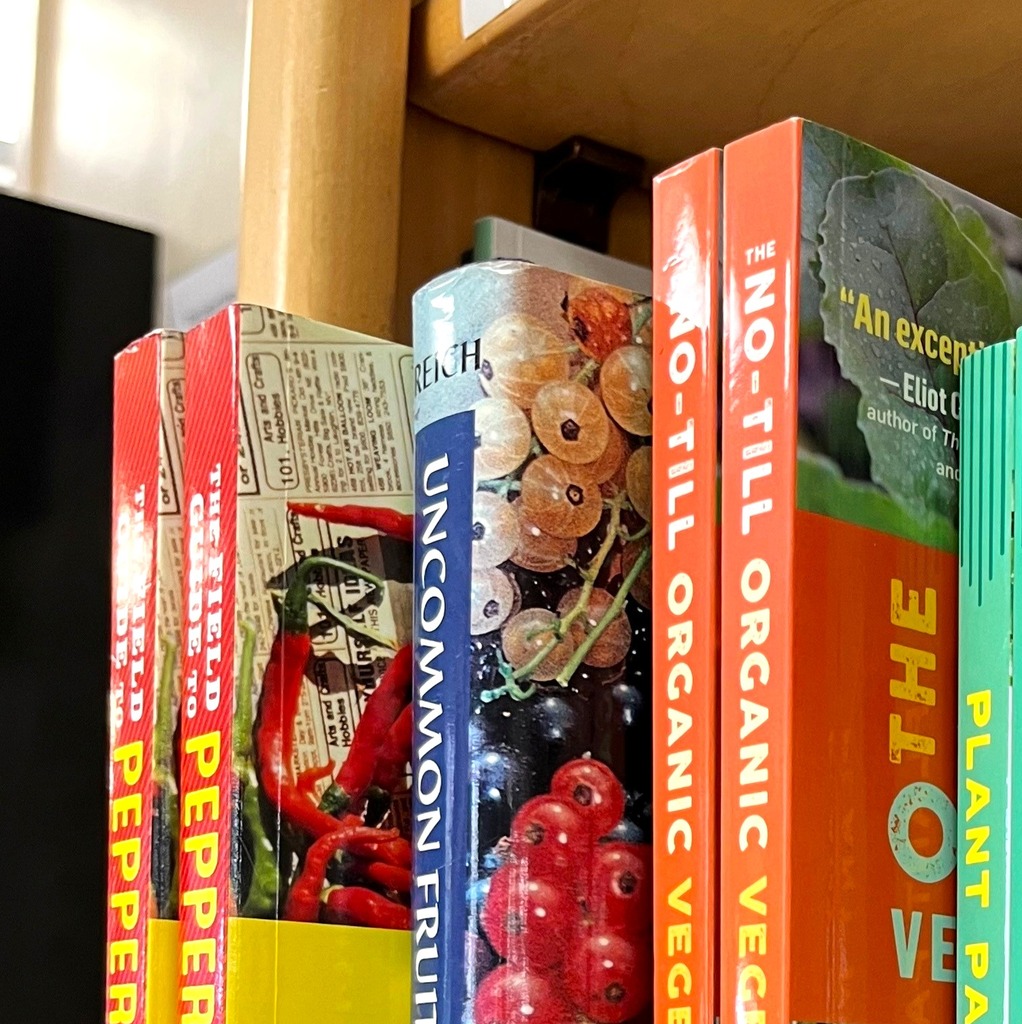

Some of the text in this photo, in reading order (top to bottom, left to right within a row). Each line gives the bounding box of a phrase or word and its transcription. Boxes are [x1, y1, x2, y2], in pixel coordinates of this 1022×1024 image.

[745, 240, 776, 266] THE
[258, 394, 268, 415] and
[263, 420, 274, 442] Arts
[271, 393, 294, 485] 101. Hobbies
[741, 268, 776, 535] NO-TILL
[867, 406, 918, 435] author
[923, 425, 937, 442] of
[206, 552, 223, 711] FIELD
[417, 452, 449, 853] UNCOMMON
[889, 578, 937, 764] THE
[187, 669, 198, 719] TO
[323, 700, 334, 720] and
[338, 698, 352, 748] Hobbies
[667, 572, 694, 855] ORGANIC
[739, 557, 771, 852] ORGANIC
[965, 689, 992, 908] PLANT
